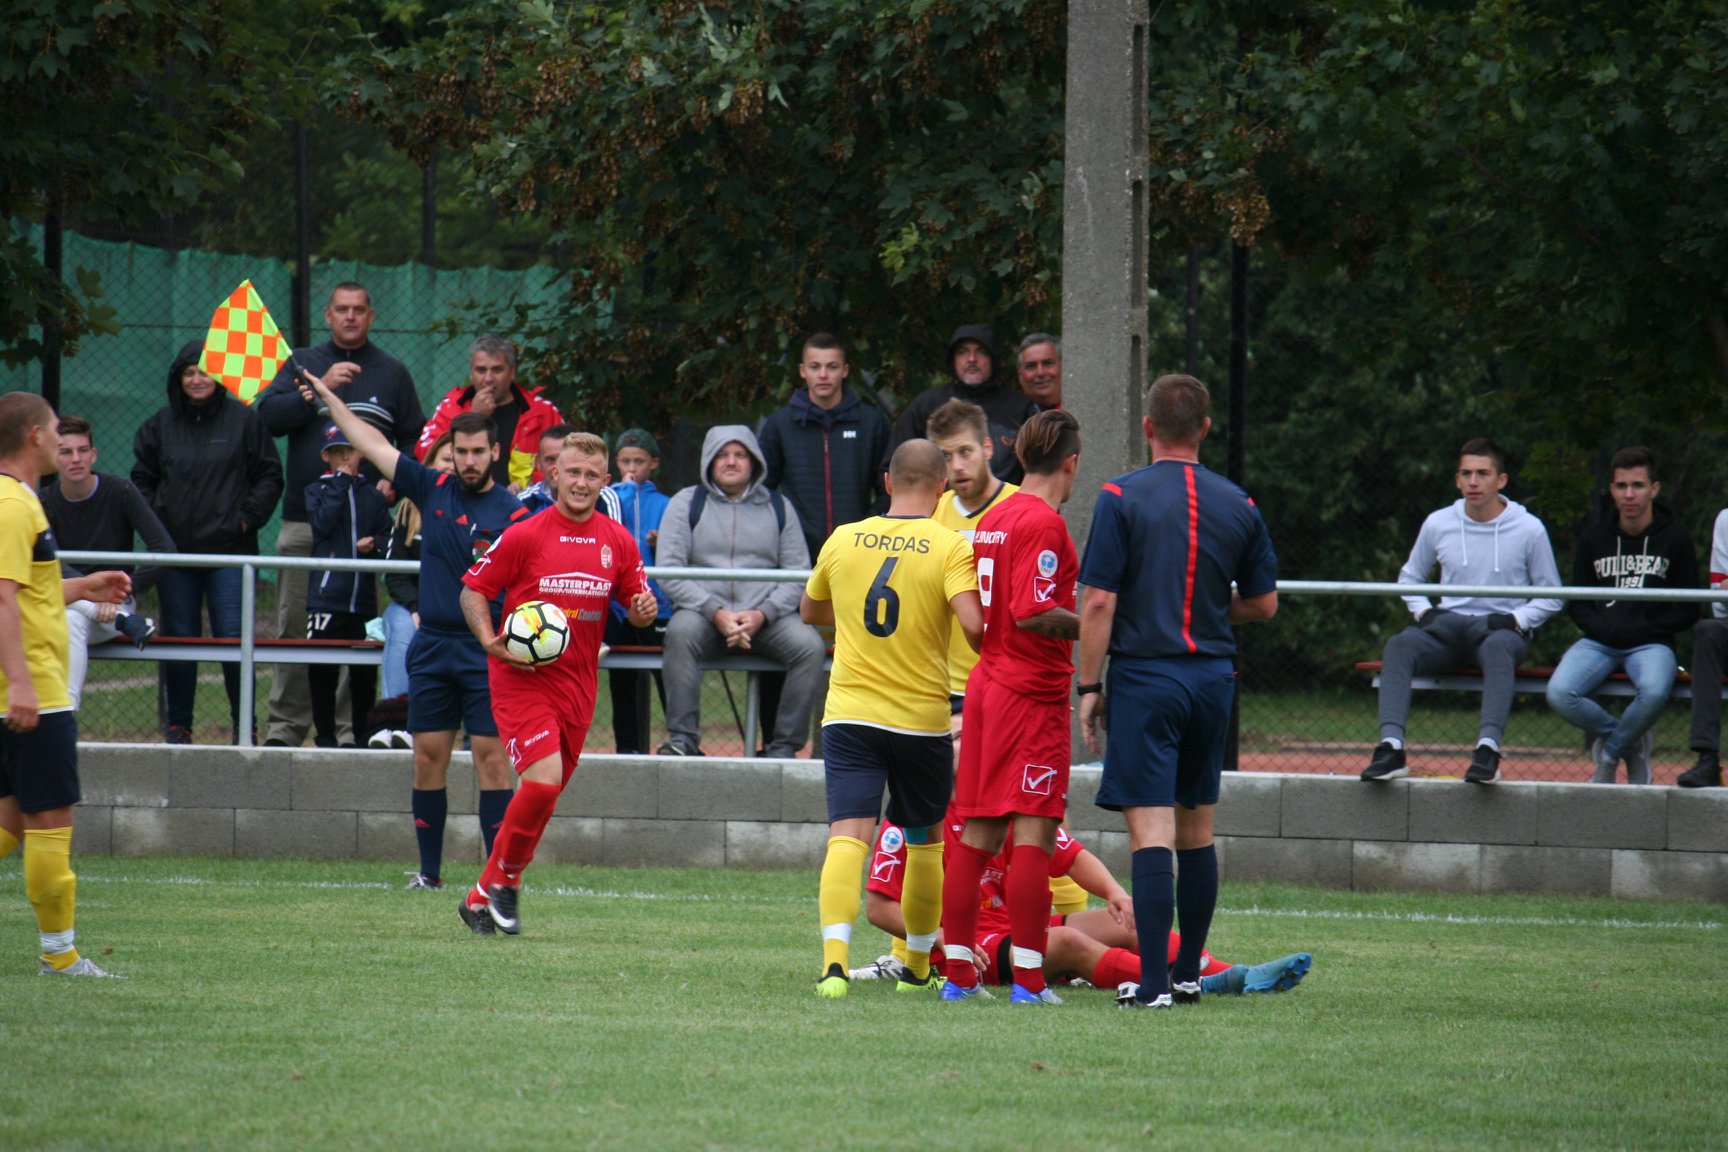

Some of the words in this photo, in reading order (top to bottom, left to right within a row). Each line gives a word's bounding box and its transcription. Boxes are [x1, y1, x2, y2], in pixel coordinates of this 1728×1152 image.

[559, 535, 596, 544] GIVOVA
[854, 532, 930, 554] TORDAS
[864, 556, 900, 638] 6
[314, 612, 332, 630] 17
